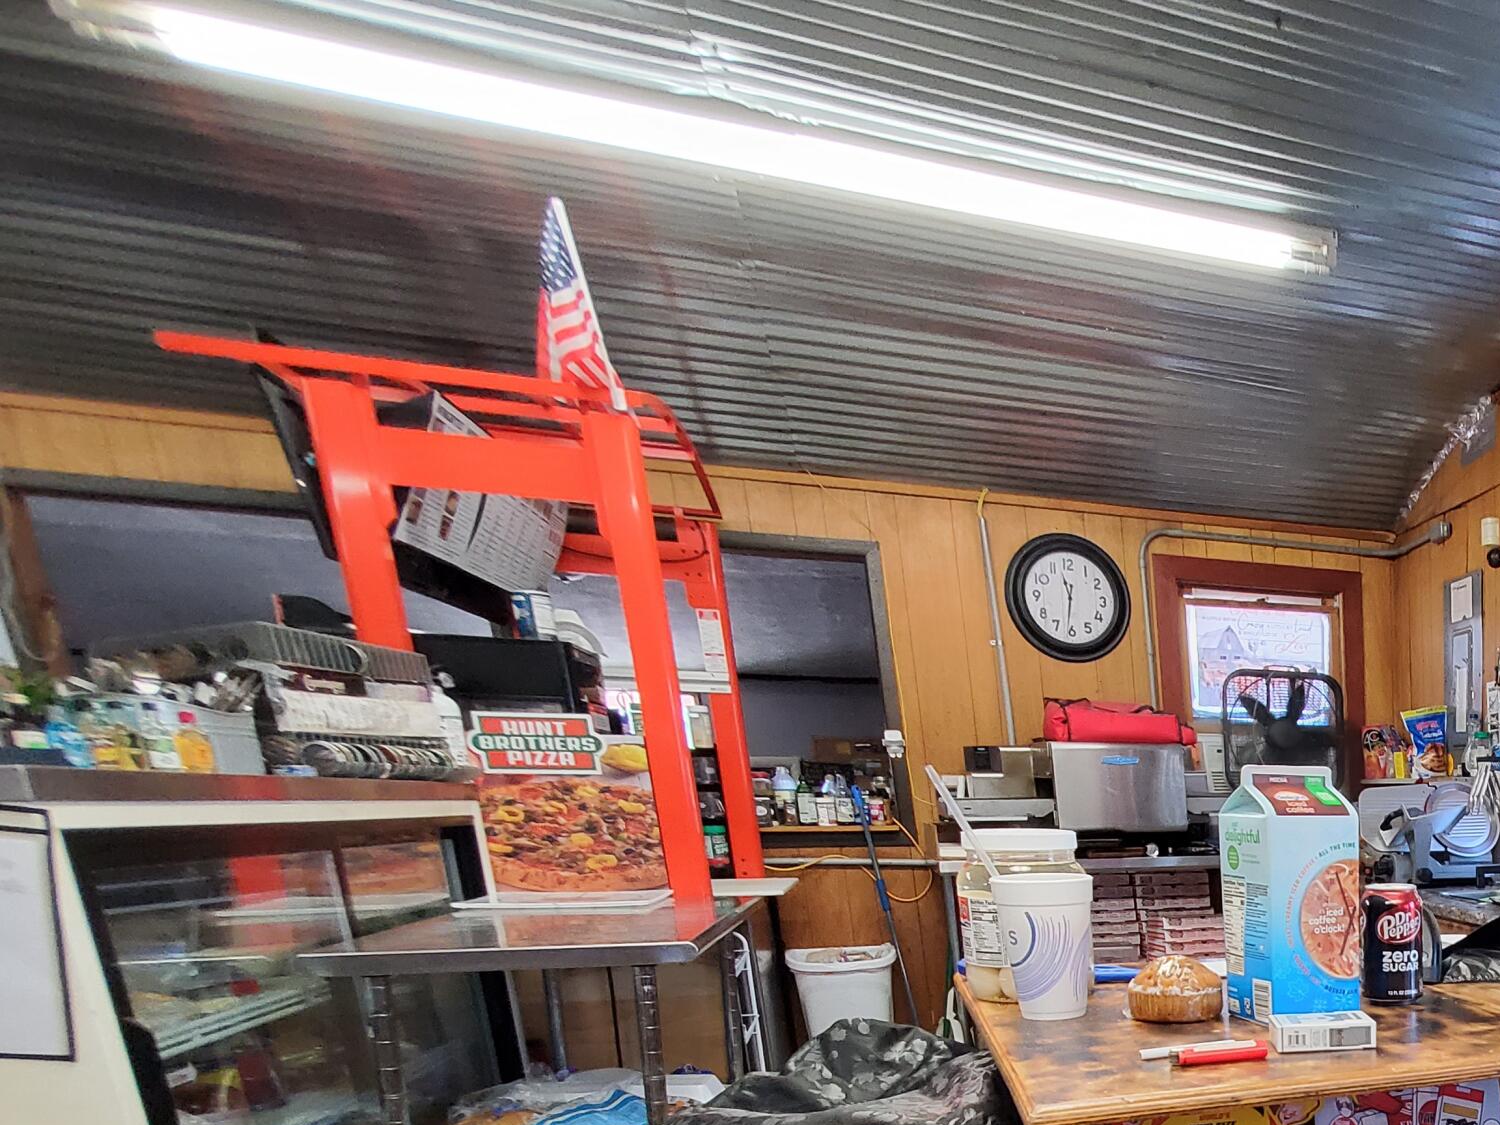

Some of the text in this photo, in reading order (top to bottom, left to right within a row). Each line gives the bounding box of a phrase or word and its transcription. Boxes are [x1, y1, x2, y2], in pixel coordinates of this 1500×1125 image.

[1050, 561, 1057, 575] 11
[1062, 557, 1074, 571] 12
[1083, 564, 1088, 578] 1
[1034, 572, 1050, 586] 10
[1094, 577, 1102, 591] 2
[1032, 589, 1041, 602] 9
[1099, 596, 1107, 609] 3
[1040, 607, 1048, 620] 8
[1094, 610, 1104, 623] 4
[1052, 619, 1061, 632] 7
[1068, 625, 1077, 638] 6
[1083, 621, 1093, 634] 5
[500, 719, 567, 737] HUNT
[476, 735, 598, 752] BROTHERS
[506, 750, 577, 767] PIZZA
[1326, 906, 1345, 917] iced
[1395, 910, 1413, 927] Dr
[1308, 916, 1338, 926] coffee
[1381, 913, 1421, 940] Pepper
[1008, 930, 1018, 946] S
[1381, 949, 1420, 963] zero
[1381, 962, 1420, 973] SUGAR
